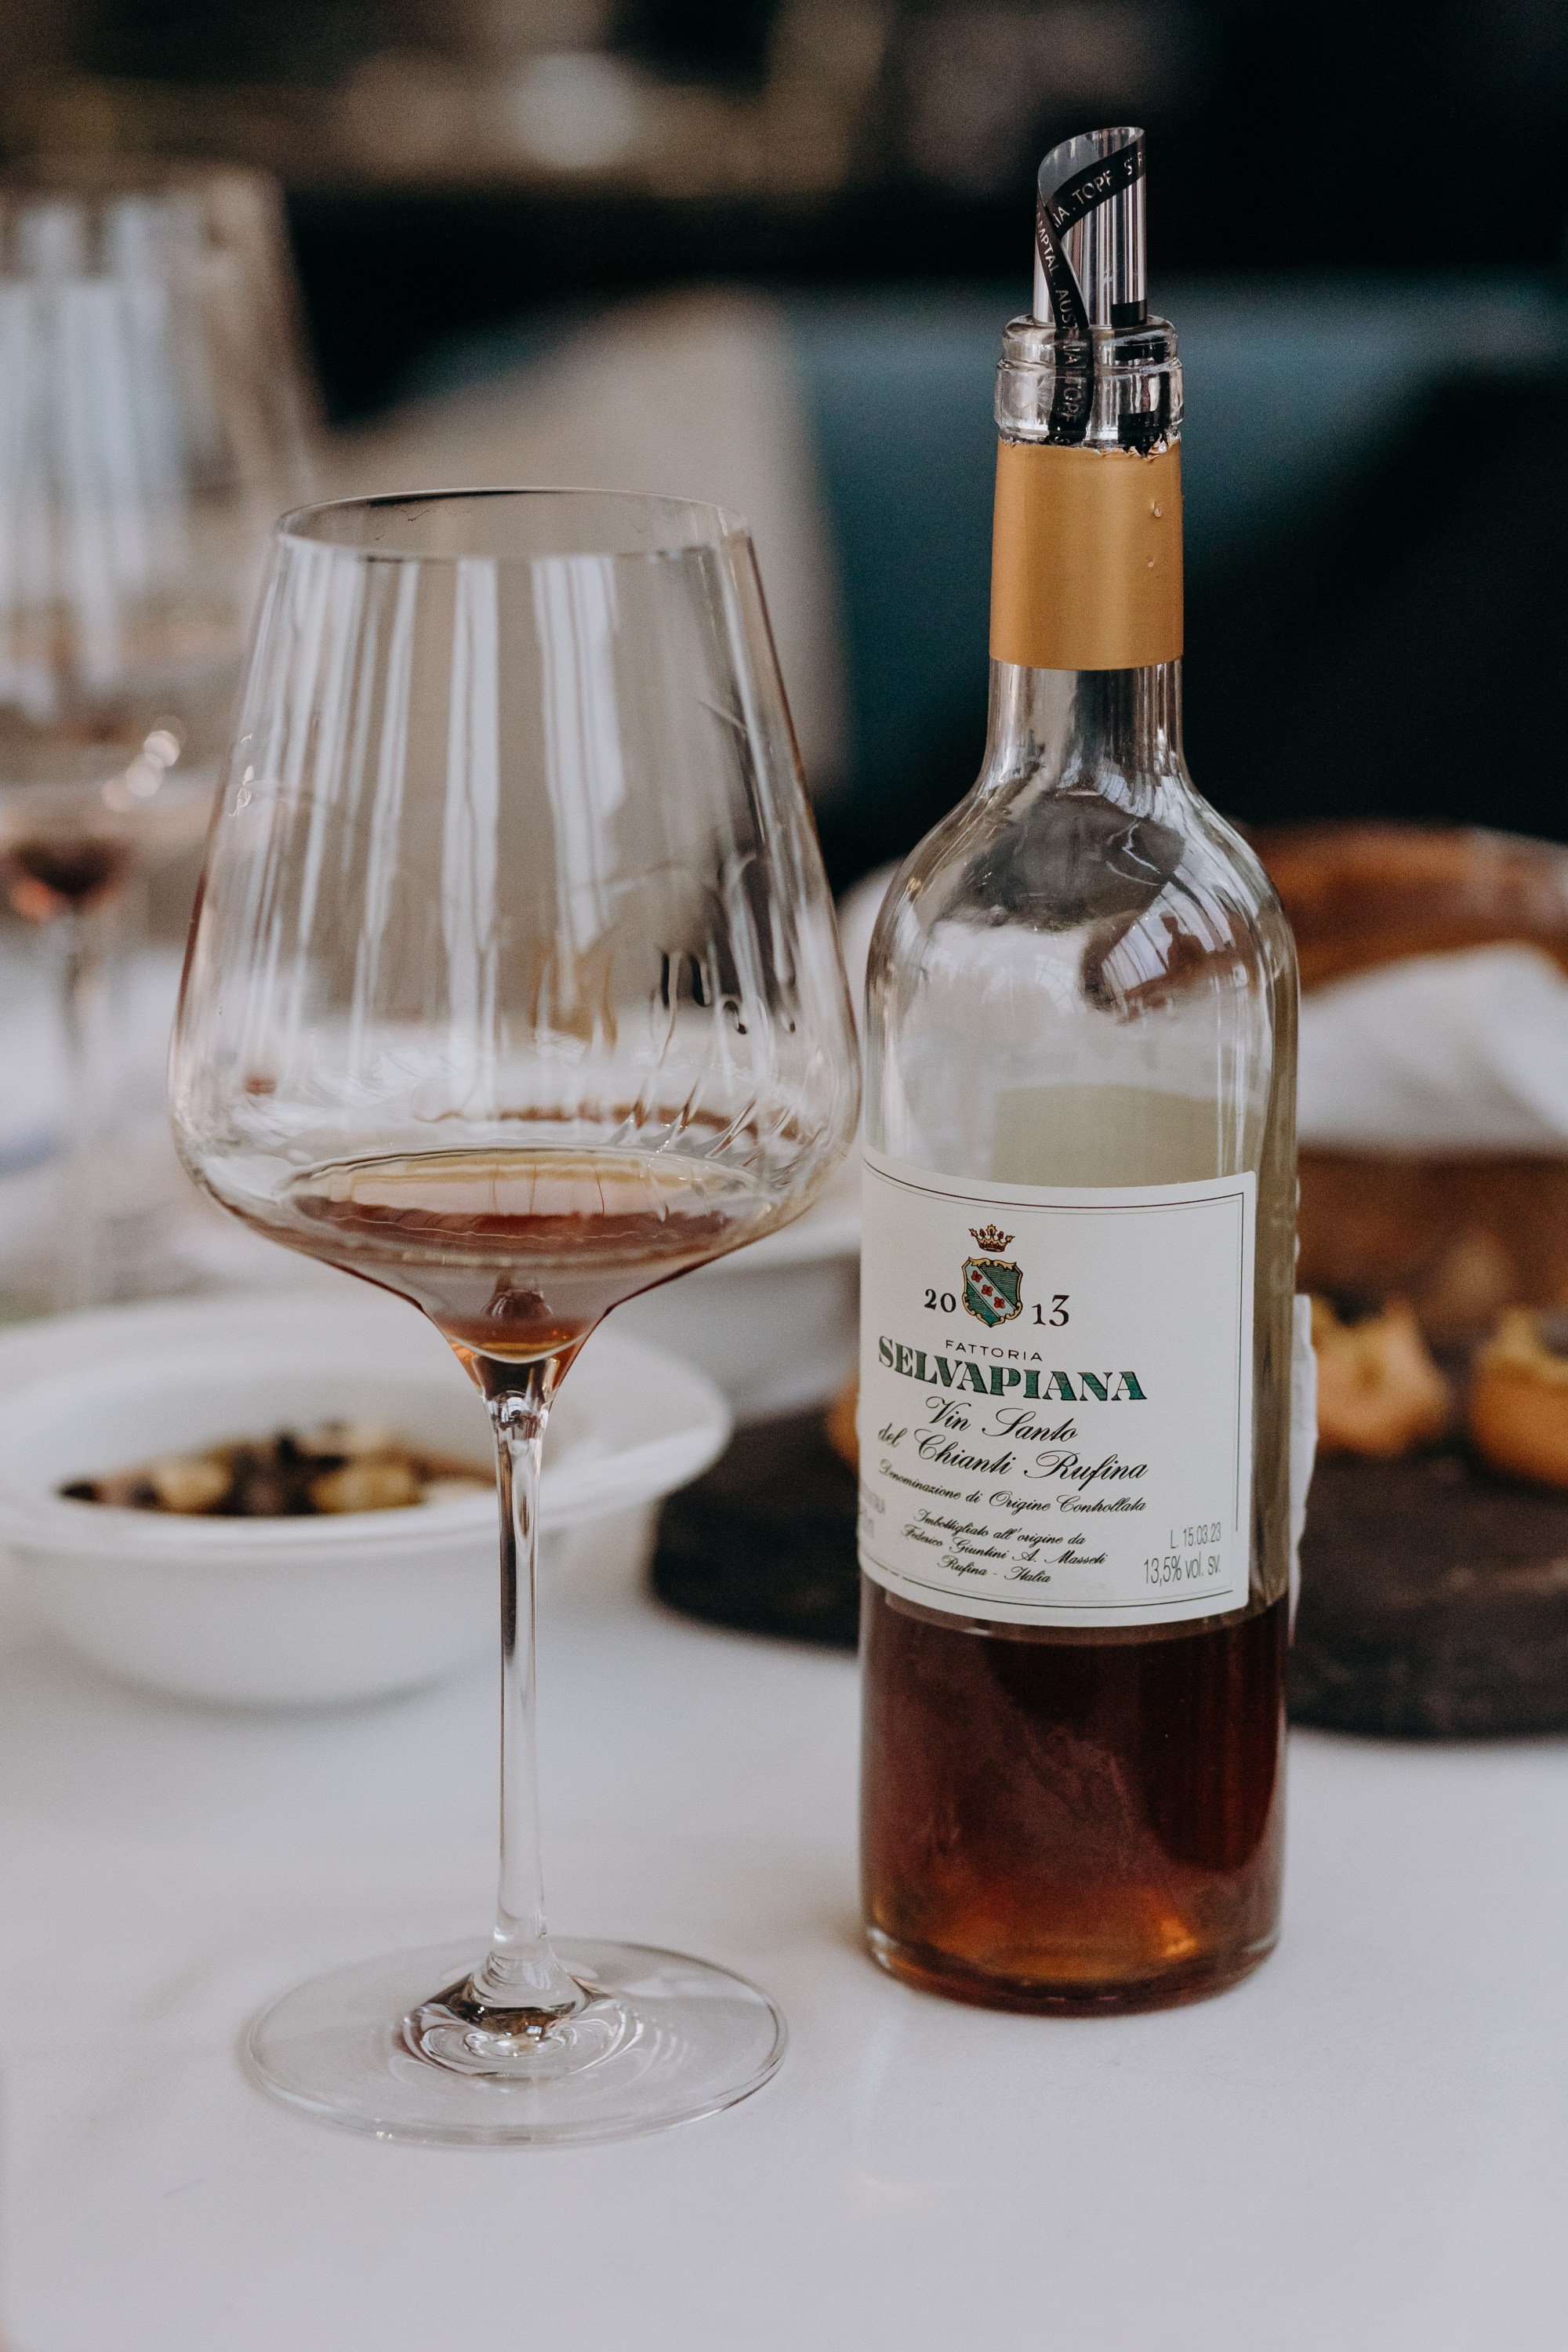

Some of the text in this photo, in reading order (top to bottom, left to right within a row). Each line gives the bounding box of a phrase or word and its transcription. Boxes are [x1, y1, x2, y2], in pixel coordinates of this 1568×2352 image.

[1071, 169, 1112, 205] TOPF
[924, 1288, 1070, 1327] 20 13
[878, 1335, 1148, 1402] SELVAPIANA
[946, 1339, 1043, 1362] FATTORIA
[925, 1396, 1079, 1443] Vin Santo
[877, 1422, 1149, 1491] del Chianti Rufina
[878, 1458, 962, 1501] Denominazione
[965, 1490, 983, 1504] di
[989, 1490, 1051, 1516] Origine
[1056, 1494, 1147, 1513] Controllata
[901, 1523, 943, 1547] Federico
[949, 1537, 1010, 1559] Giuntini
[1011, 1548, 1037, 1563] A.
[913, 1508, 1087, 1549] Imbottigliato all'origine da
[1171, 1522, 1221, 1549] L. 15.03.23
[937, 1555, 988, 1577] Rufina
[1004, 1566, 1052, 1583] Italia
[1144, 1552, 1221, 1588] 13,5% vol. sv.
